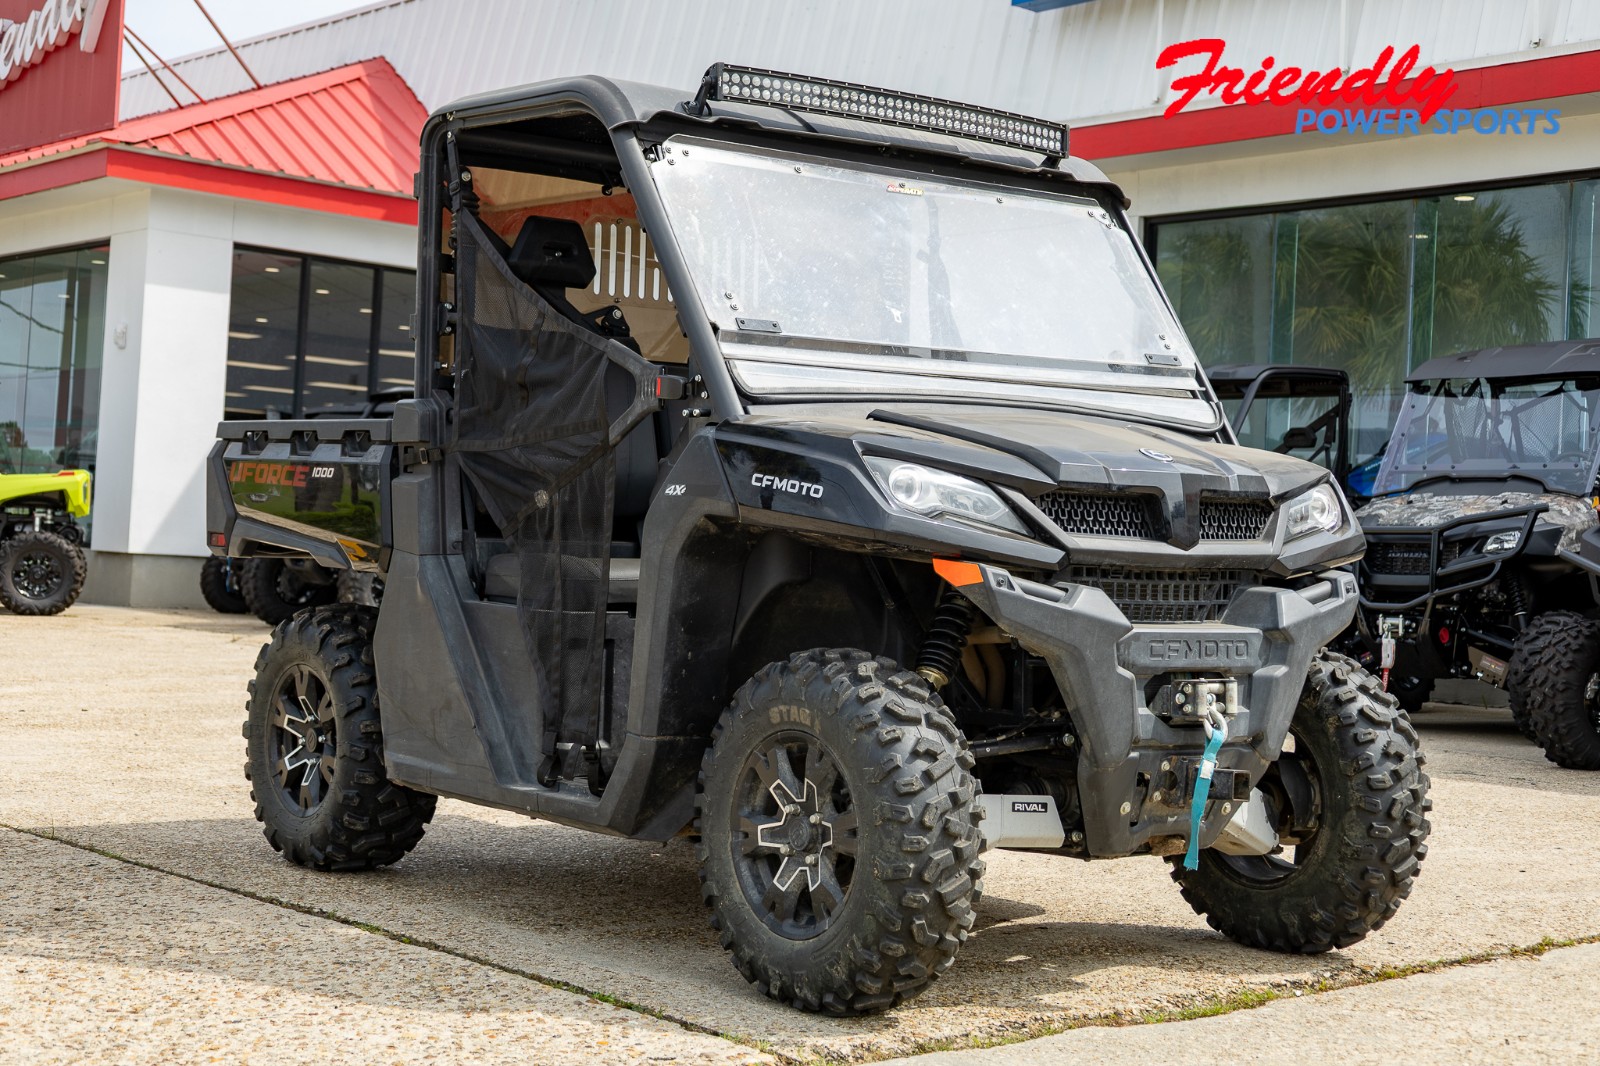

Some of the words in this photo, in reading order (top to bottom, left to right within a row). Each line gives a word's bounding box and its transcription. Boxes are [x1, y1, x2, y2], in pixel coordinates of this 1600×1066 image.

[229, 461, 310, 487] UFORCE
[311, 467, 335, 478] 1000
[751, 473, 824, 499] CFMOTO
[1148, 639, 1249, 661] CFMOTO
[1014, 803, 1046, 812] RIVAL
